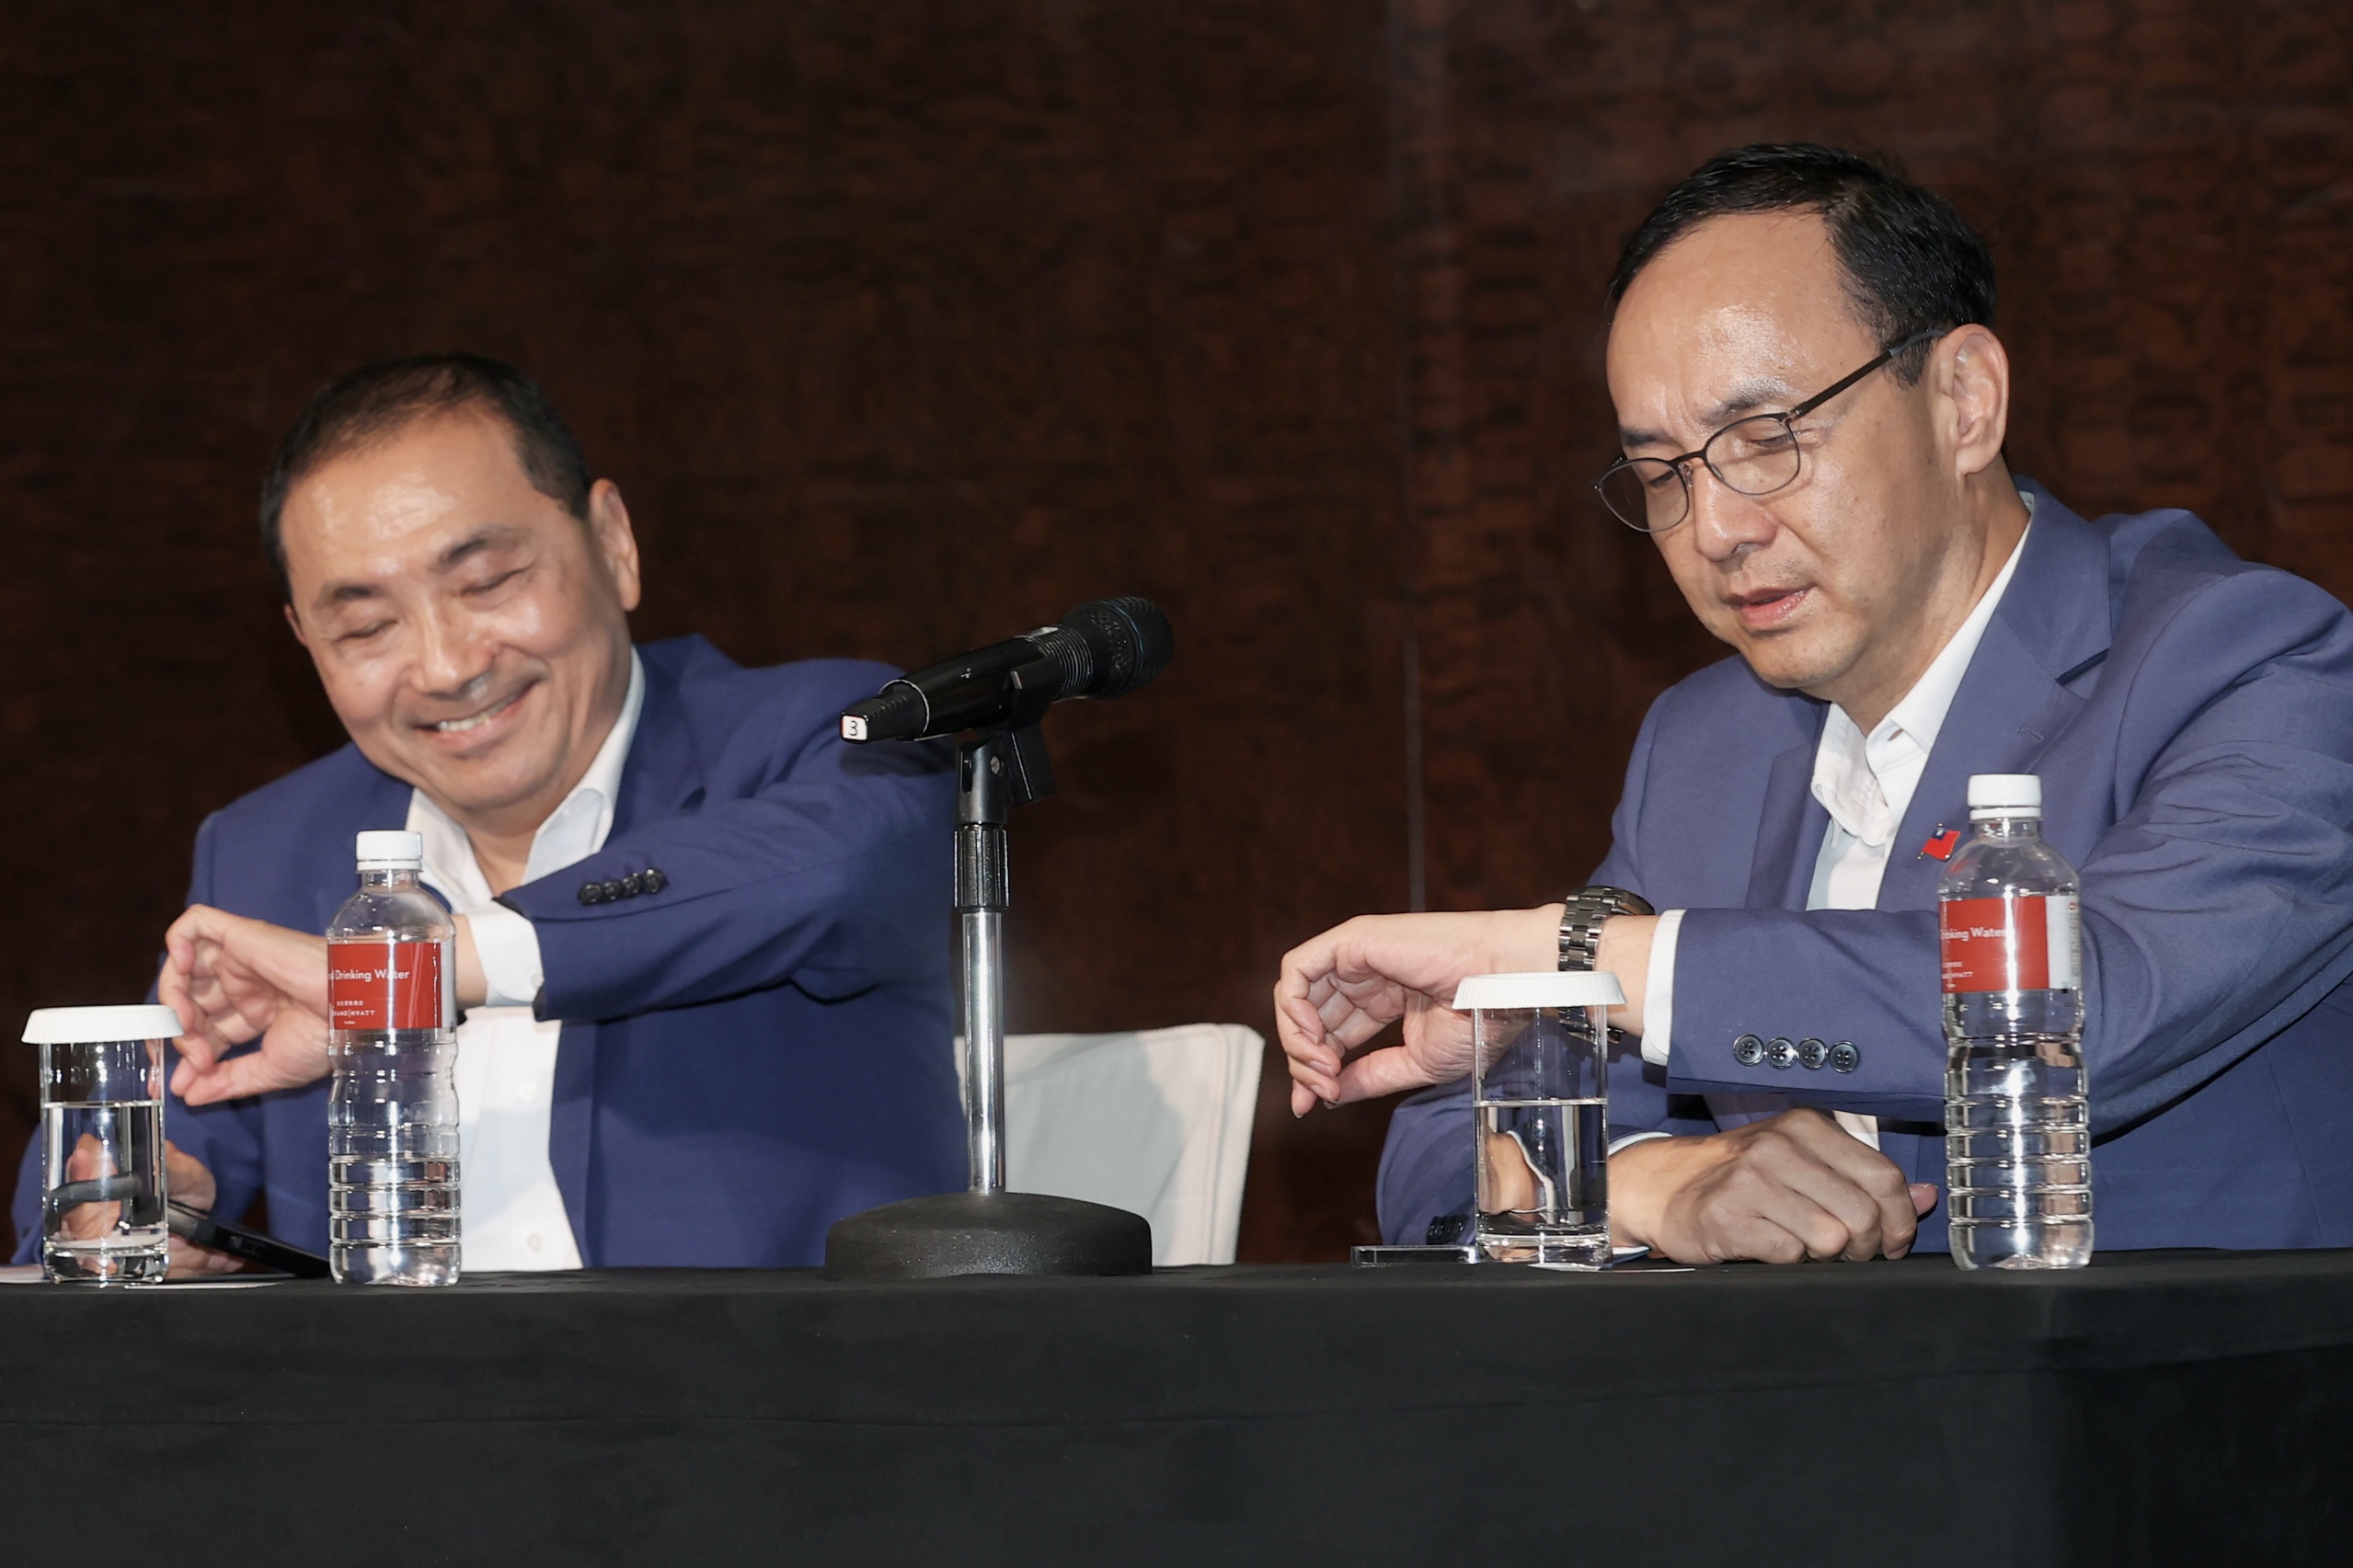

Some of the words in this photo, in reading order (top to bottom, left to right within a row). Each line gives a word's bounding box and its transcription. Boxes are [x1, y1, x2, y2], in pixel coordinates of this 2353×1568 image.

[848, 719, 858, 737] 3
[334, 968, 373, 983] Drinking
[373, 968, 410, 979] Wter
